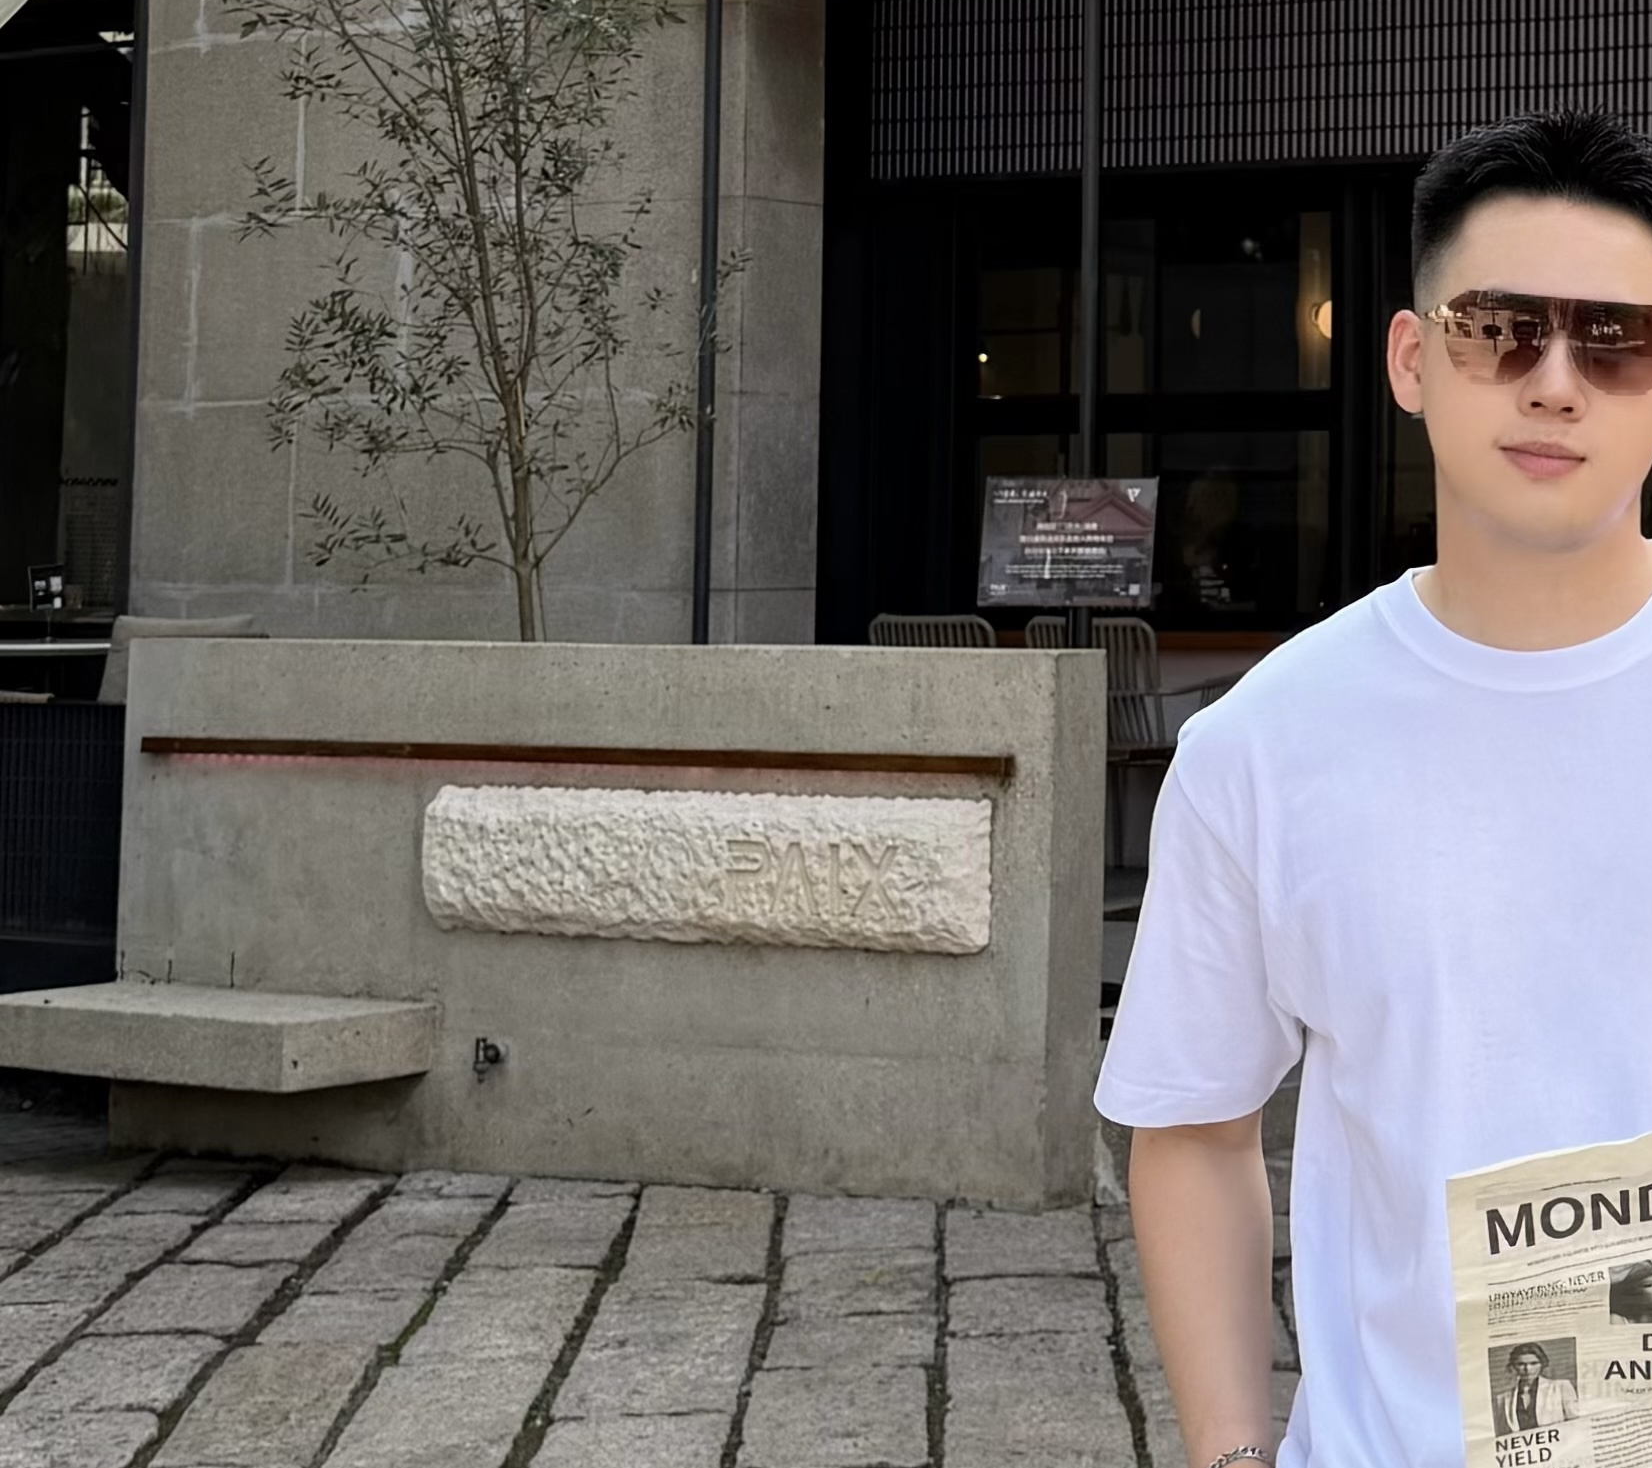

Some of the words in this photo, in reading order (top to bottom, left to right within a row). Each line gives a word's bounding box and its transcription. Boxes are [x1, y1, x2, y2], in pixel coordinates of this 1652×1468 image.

[722, 839, 900, 918] PAIX
[1495, 1429, 1561, 1453] NEVER
[1495, 1447, 1552, 1468] YIELD
